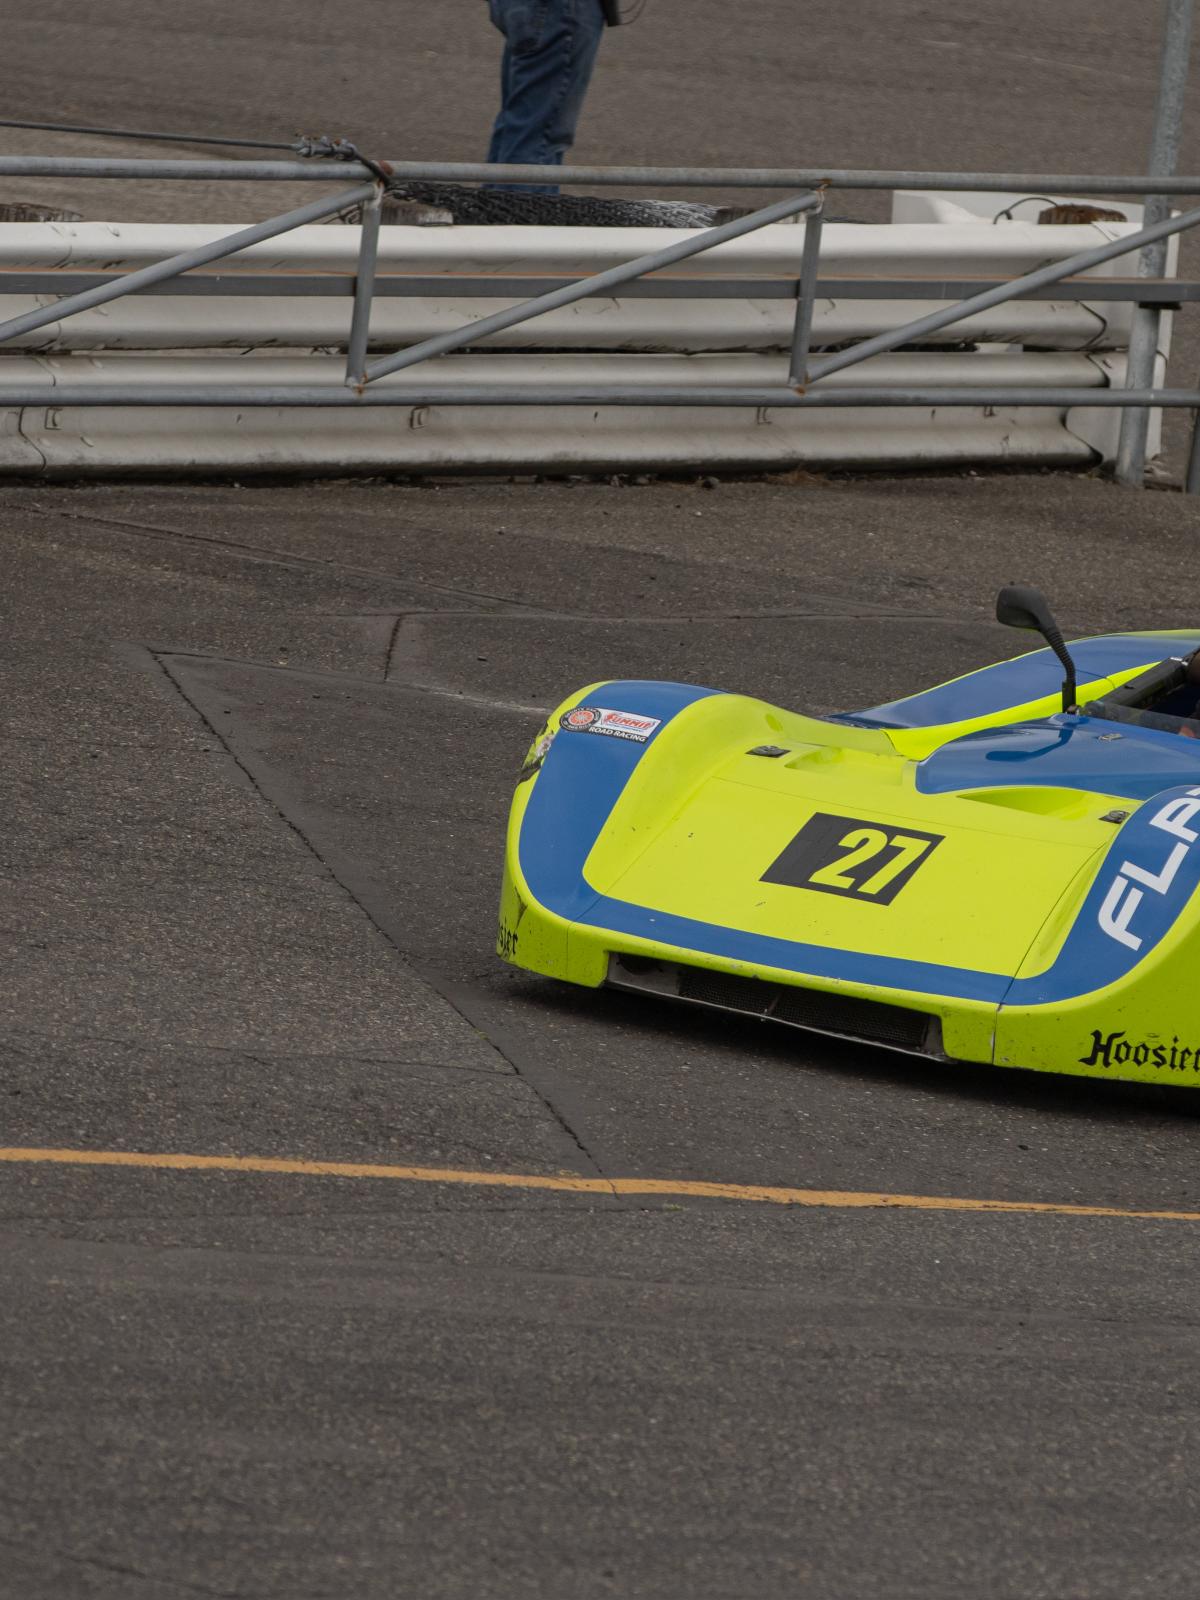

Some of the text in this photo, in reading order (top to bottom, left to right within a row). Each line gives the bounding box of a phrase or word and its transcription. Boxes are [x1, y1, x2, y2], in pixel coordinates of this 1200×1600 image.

[588, 726, 613, 736] ROAD
[613, 731, 646, 742] RACING
[808, 828, 932, 895] 27
